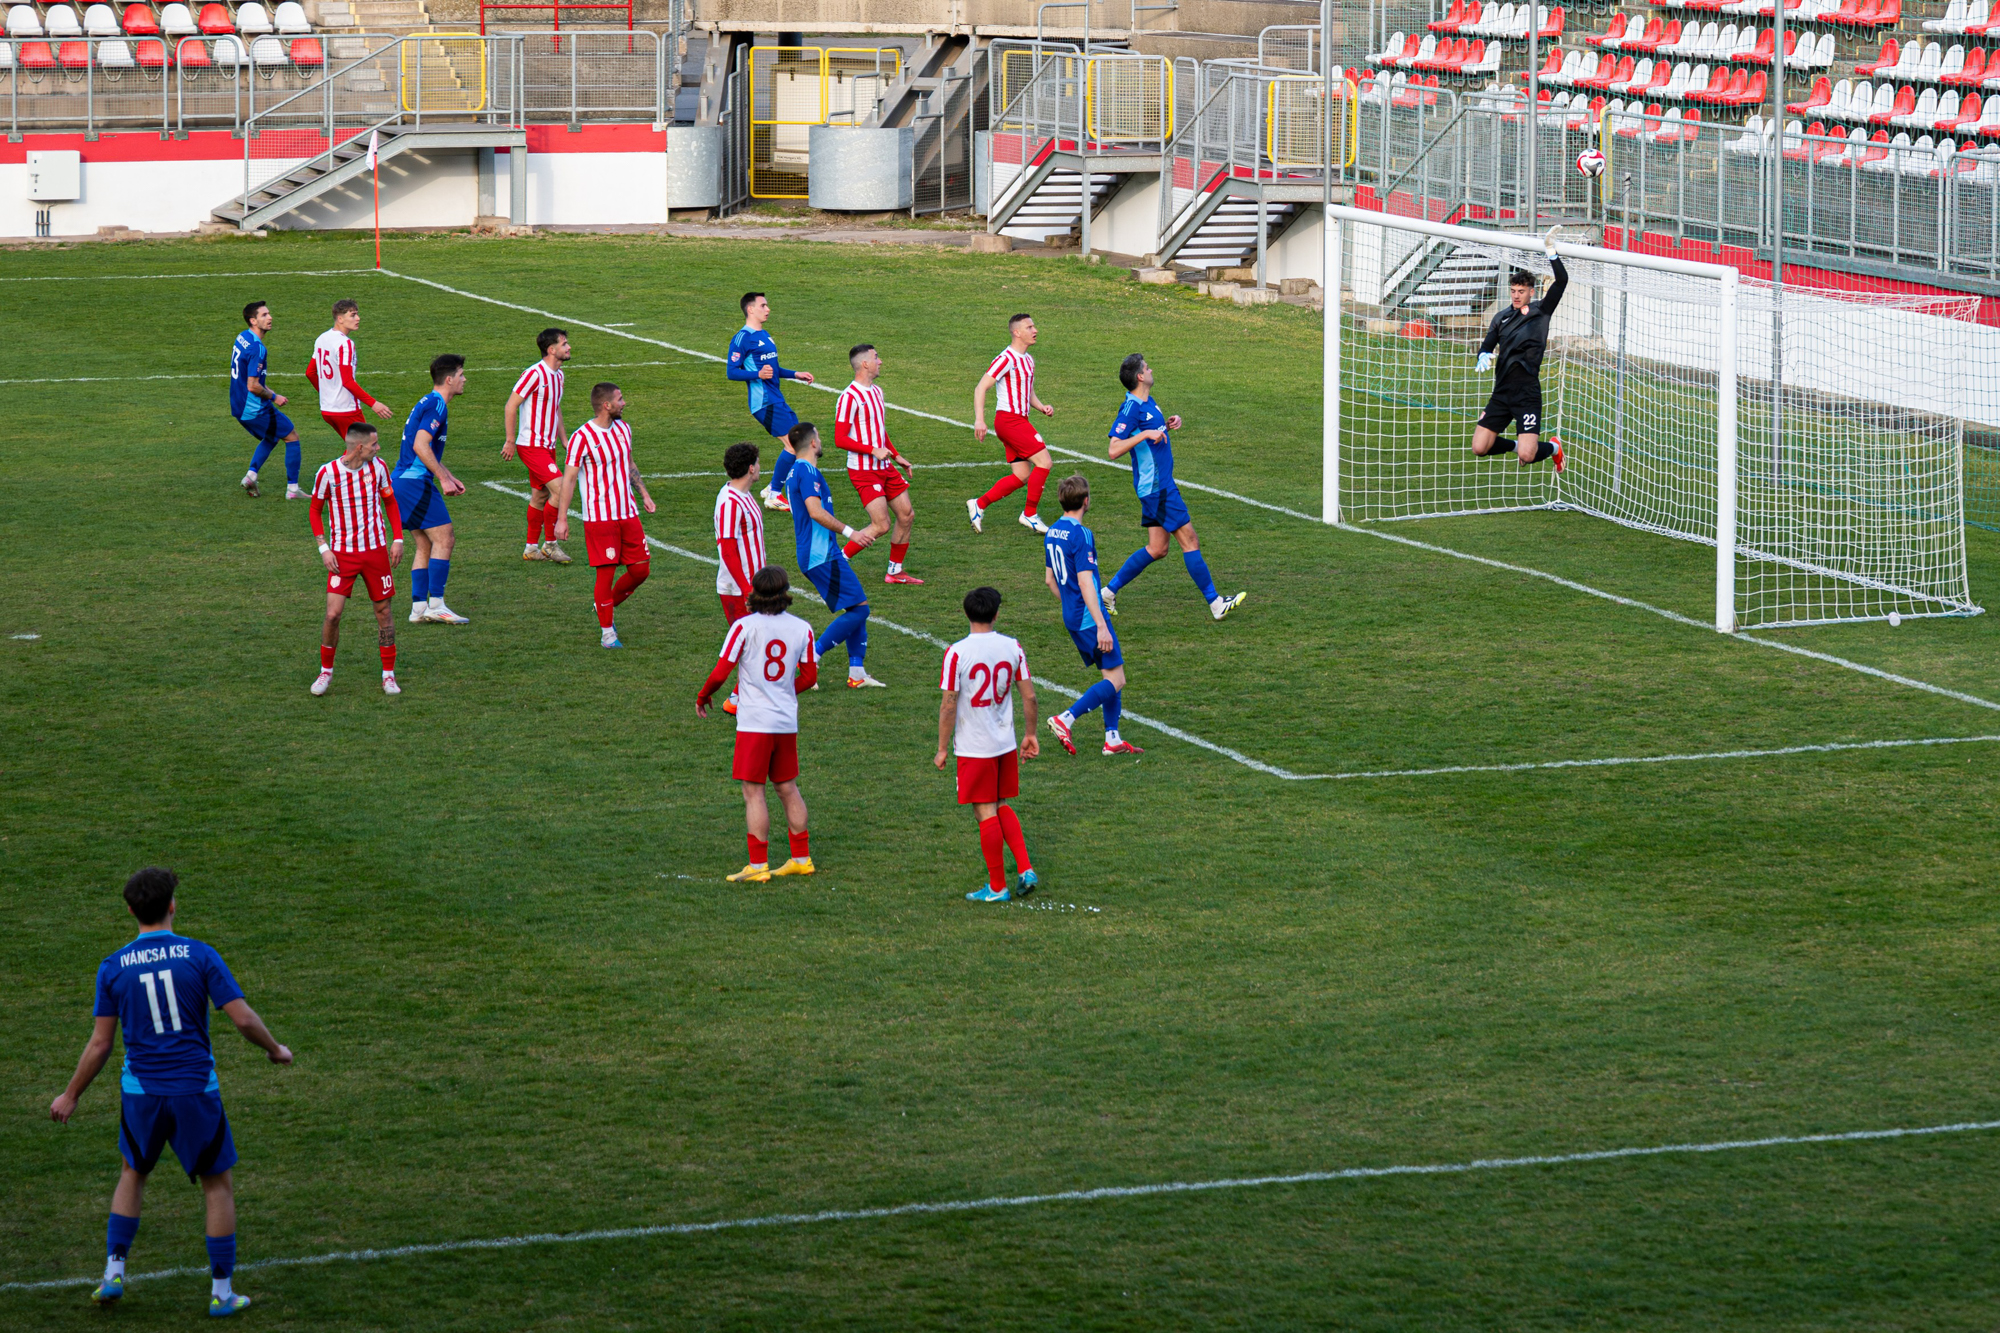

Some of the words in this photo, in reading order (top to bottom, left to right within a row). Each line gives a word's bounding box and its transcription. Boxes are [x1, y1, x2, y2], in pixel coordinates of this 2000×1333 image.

[317, 347, 334, 380] 15
[1523, 413, 1537, 426] 22
[381, 574, 393, 589] 10
[1046, 543, 1068, 586] 10
[763, 638, 787, 682] 8
[968, 660, 1013, 708] 20
[120, 946, 168, 968] IVÁNCSA
[169, 944, 191, 959] KSE
[139, 968, 182, 1035] 11
